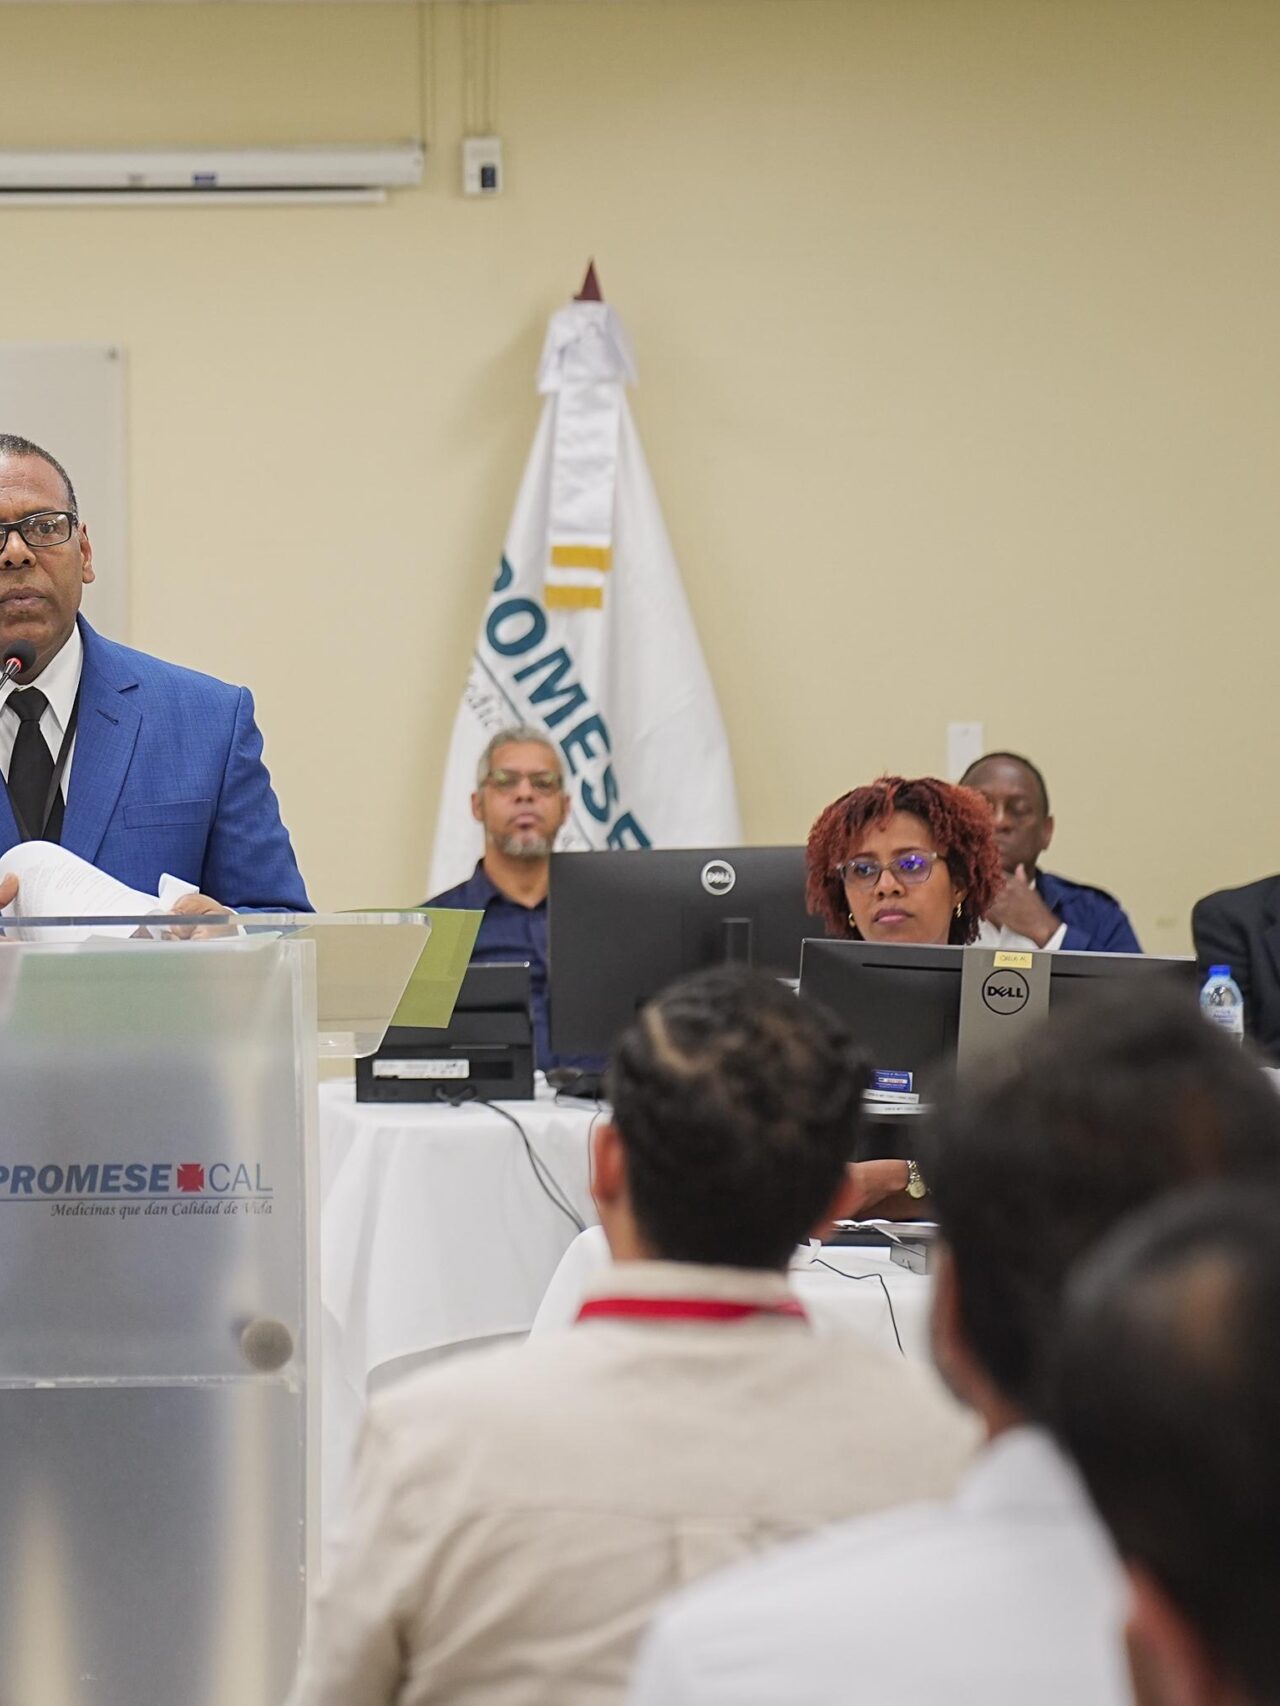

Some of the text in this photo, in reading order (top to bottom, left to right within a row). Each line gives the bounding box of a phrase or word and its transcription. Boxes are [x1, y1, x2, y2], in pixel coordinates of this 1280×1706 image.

[706, 871, 731, 884] DELL
[987, 986, 1024, 998] DELL
[209, 1163, 273, 1192] CAL
[50, 1202, 116, 1217] Medicinas
[119, 1205, 140, 1220] que
[144, 1201, 168, 1216] dan
[172, 1201, 222, 1217] Calidad
[224, 1201, 239, 1215] de
